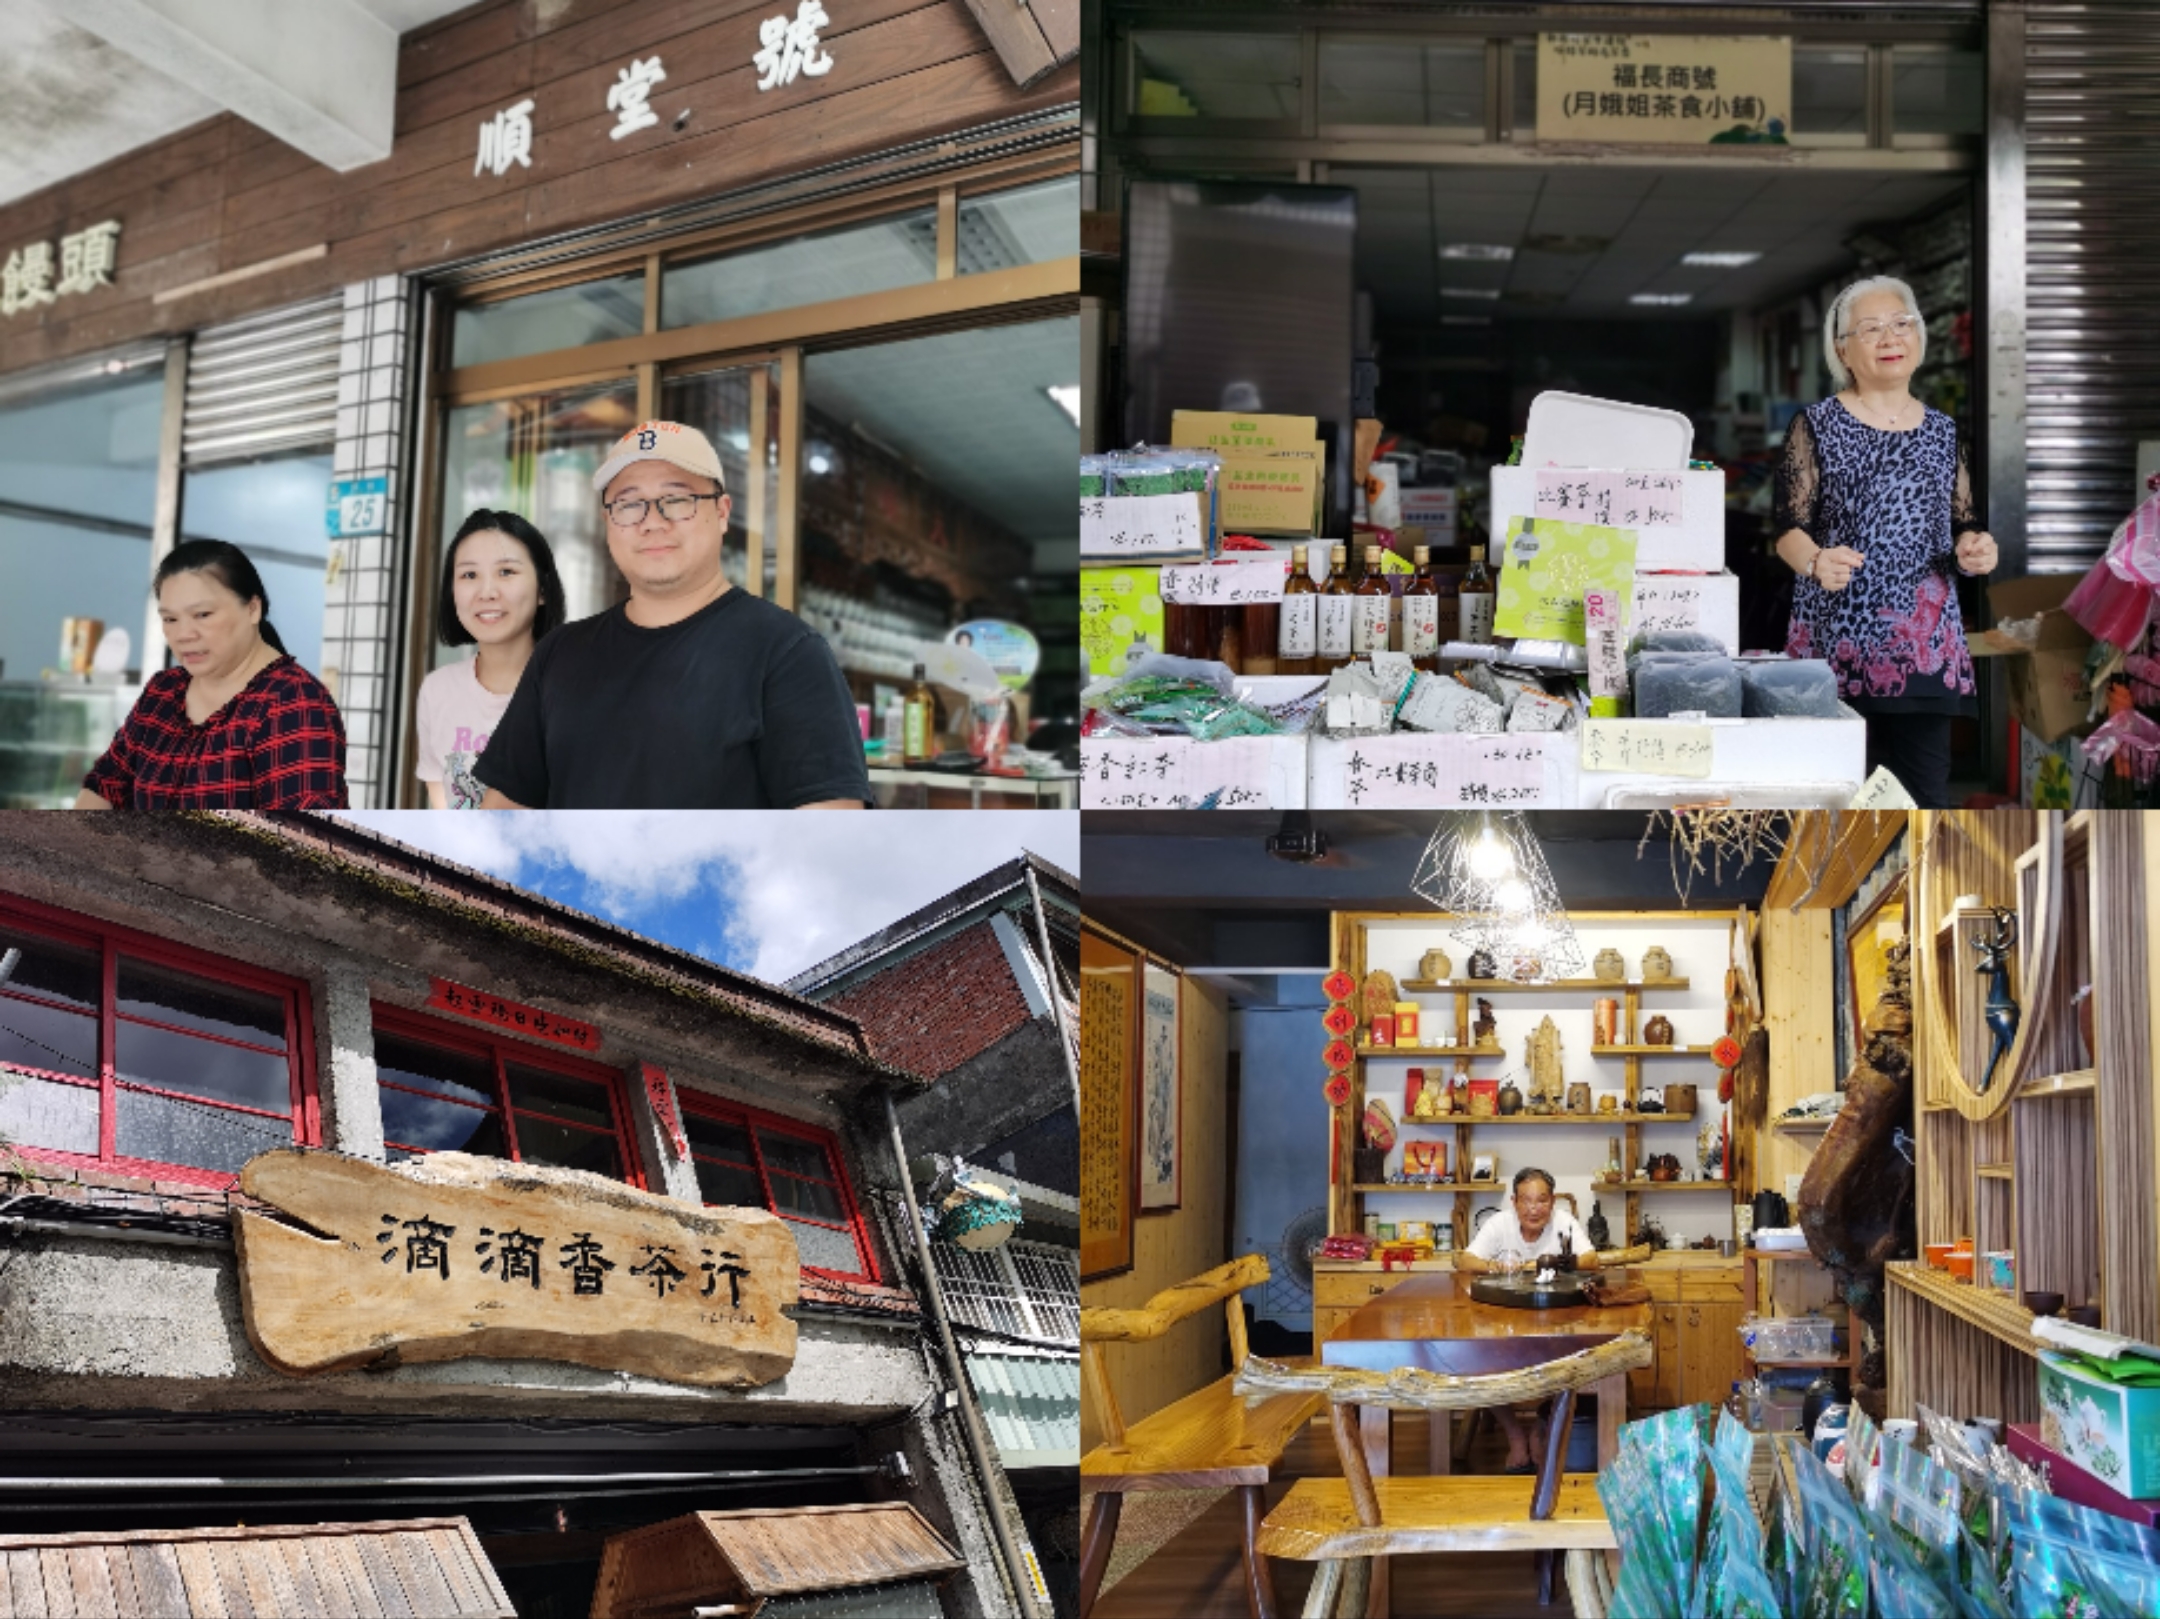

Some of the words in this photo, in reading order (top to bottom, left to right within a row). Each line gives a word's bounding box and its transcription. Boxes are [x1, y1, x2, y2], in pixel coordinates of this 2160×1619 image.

[473, 0, 835, 178] 順堂號
[1612, 63, 1717, 91] 福長商號
[350, 498, 376, 529] 25
[375, 1213, 753, 1309] 滴滴香茶行
